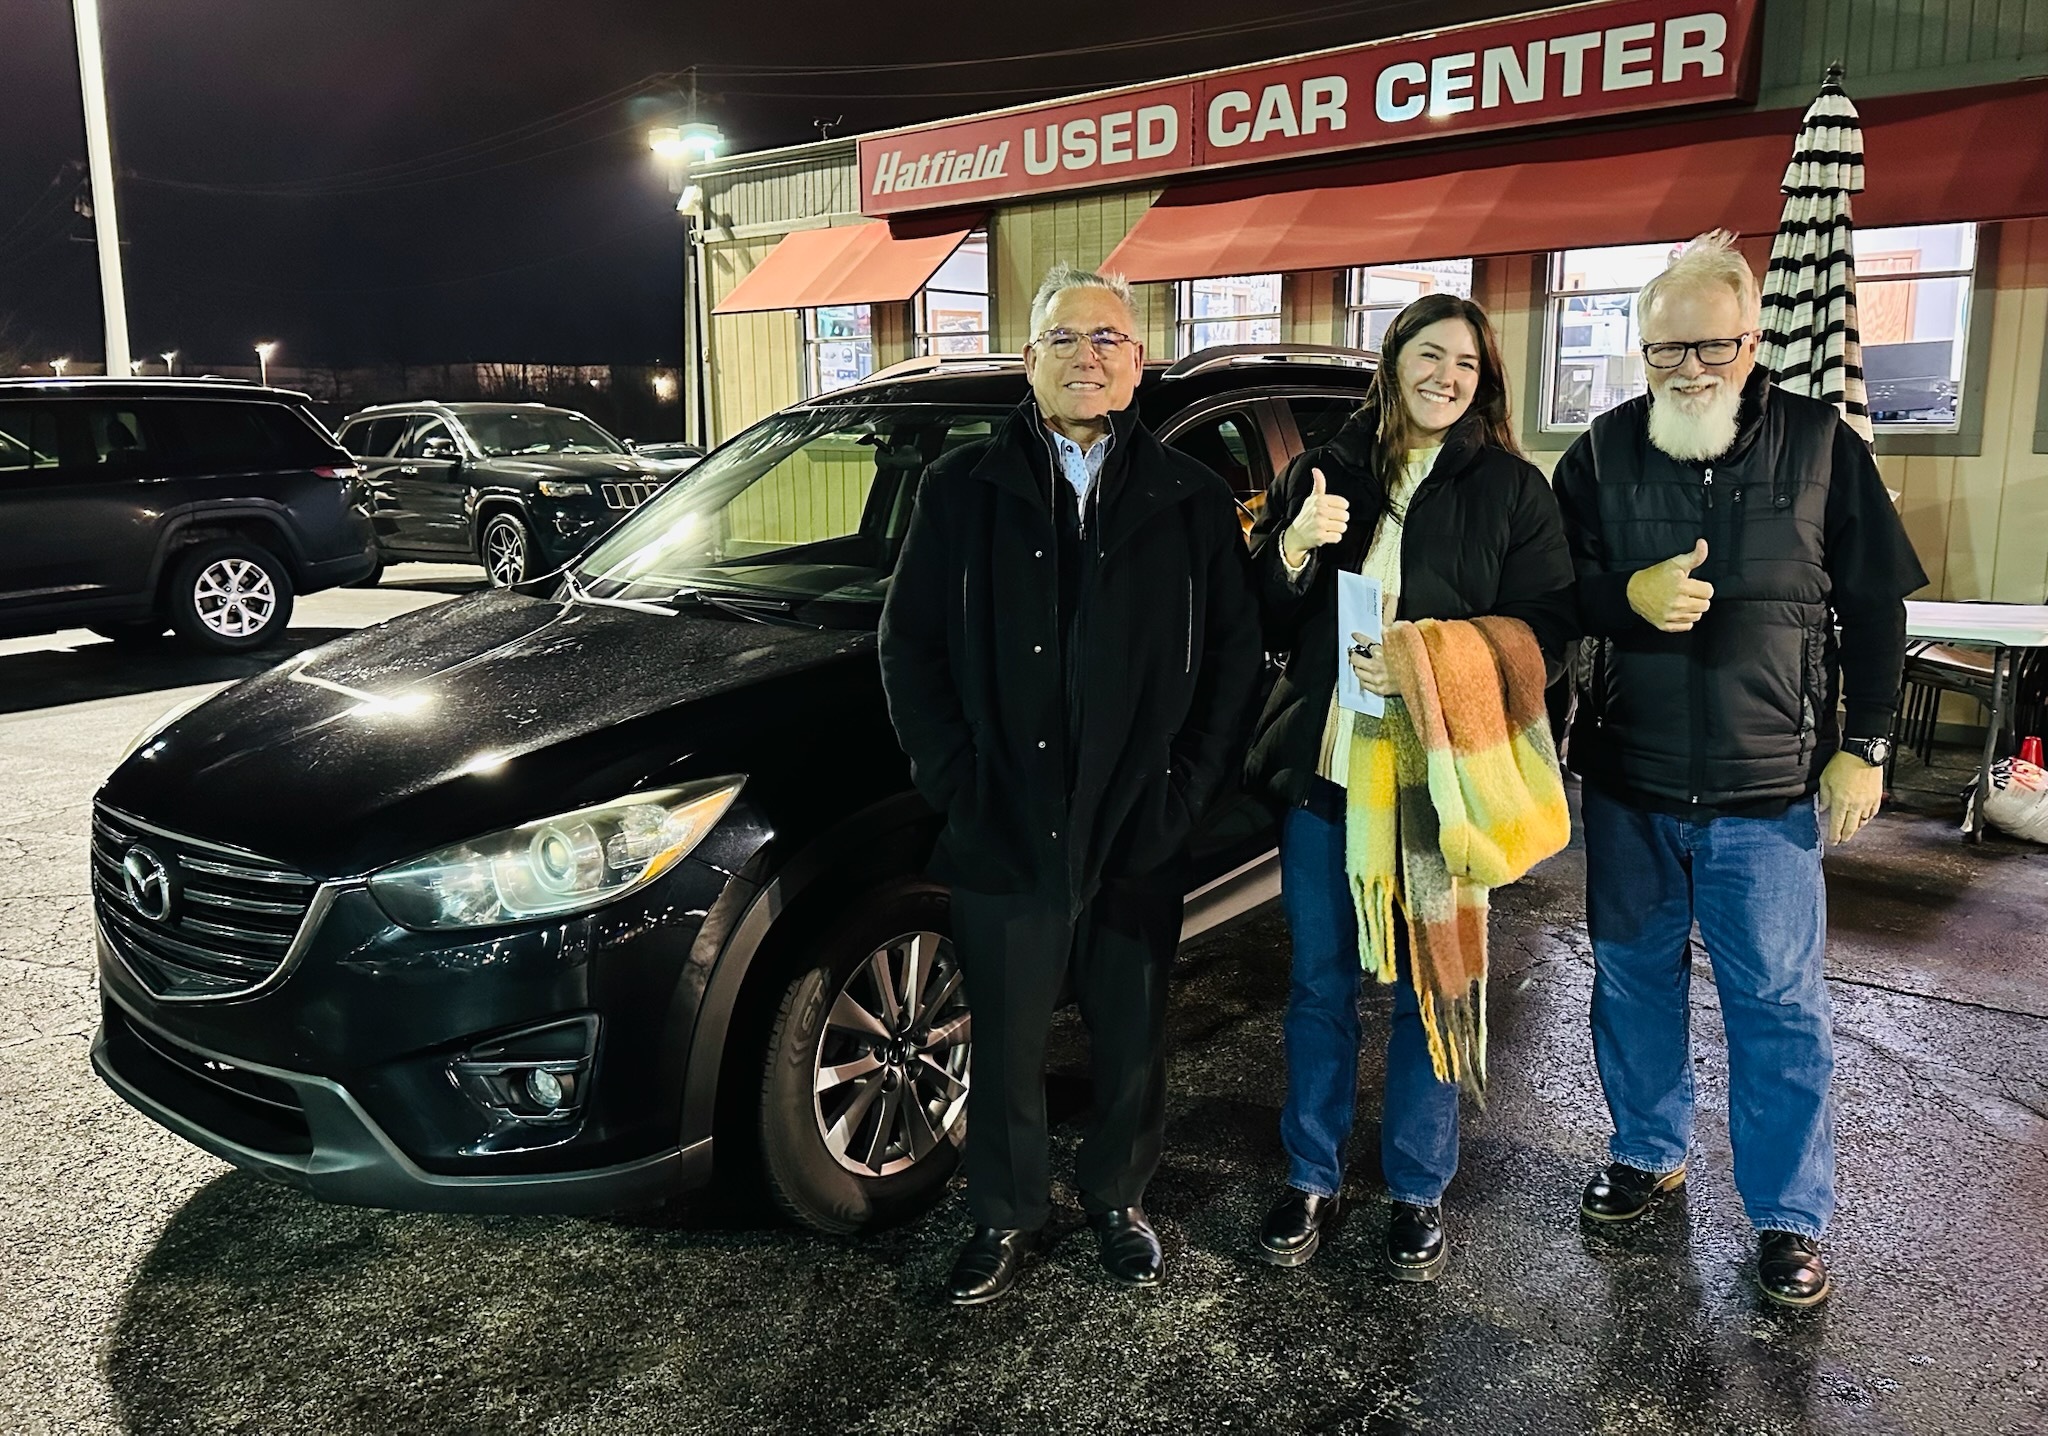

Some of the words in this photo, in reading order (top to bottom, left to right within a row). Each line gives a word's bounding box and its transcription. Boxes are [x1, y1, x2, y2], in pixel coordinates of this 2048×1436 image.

[871, 141, 1009, 195] Hatfield
[1023, 103, 1178, 175] USED
[1207, 75, 1348, 148] CAR
[1375, 12, 1727, 123] CENTER
